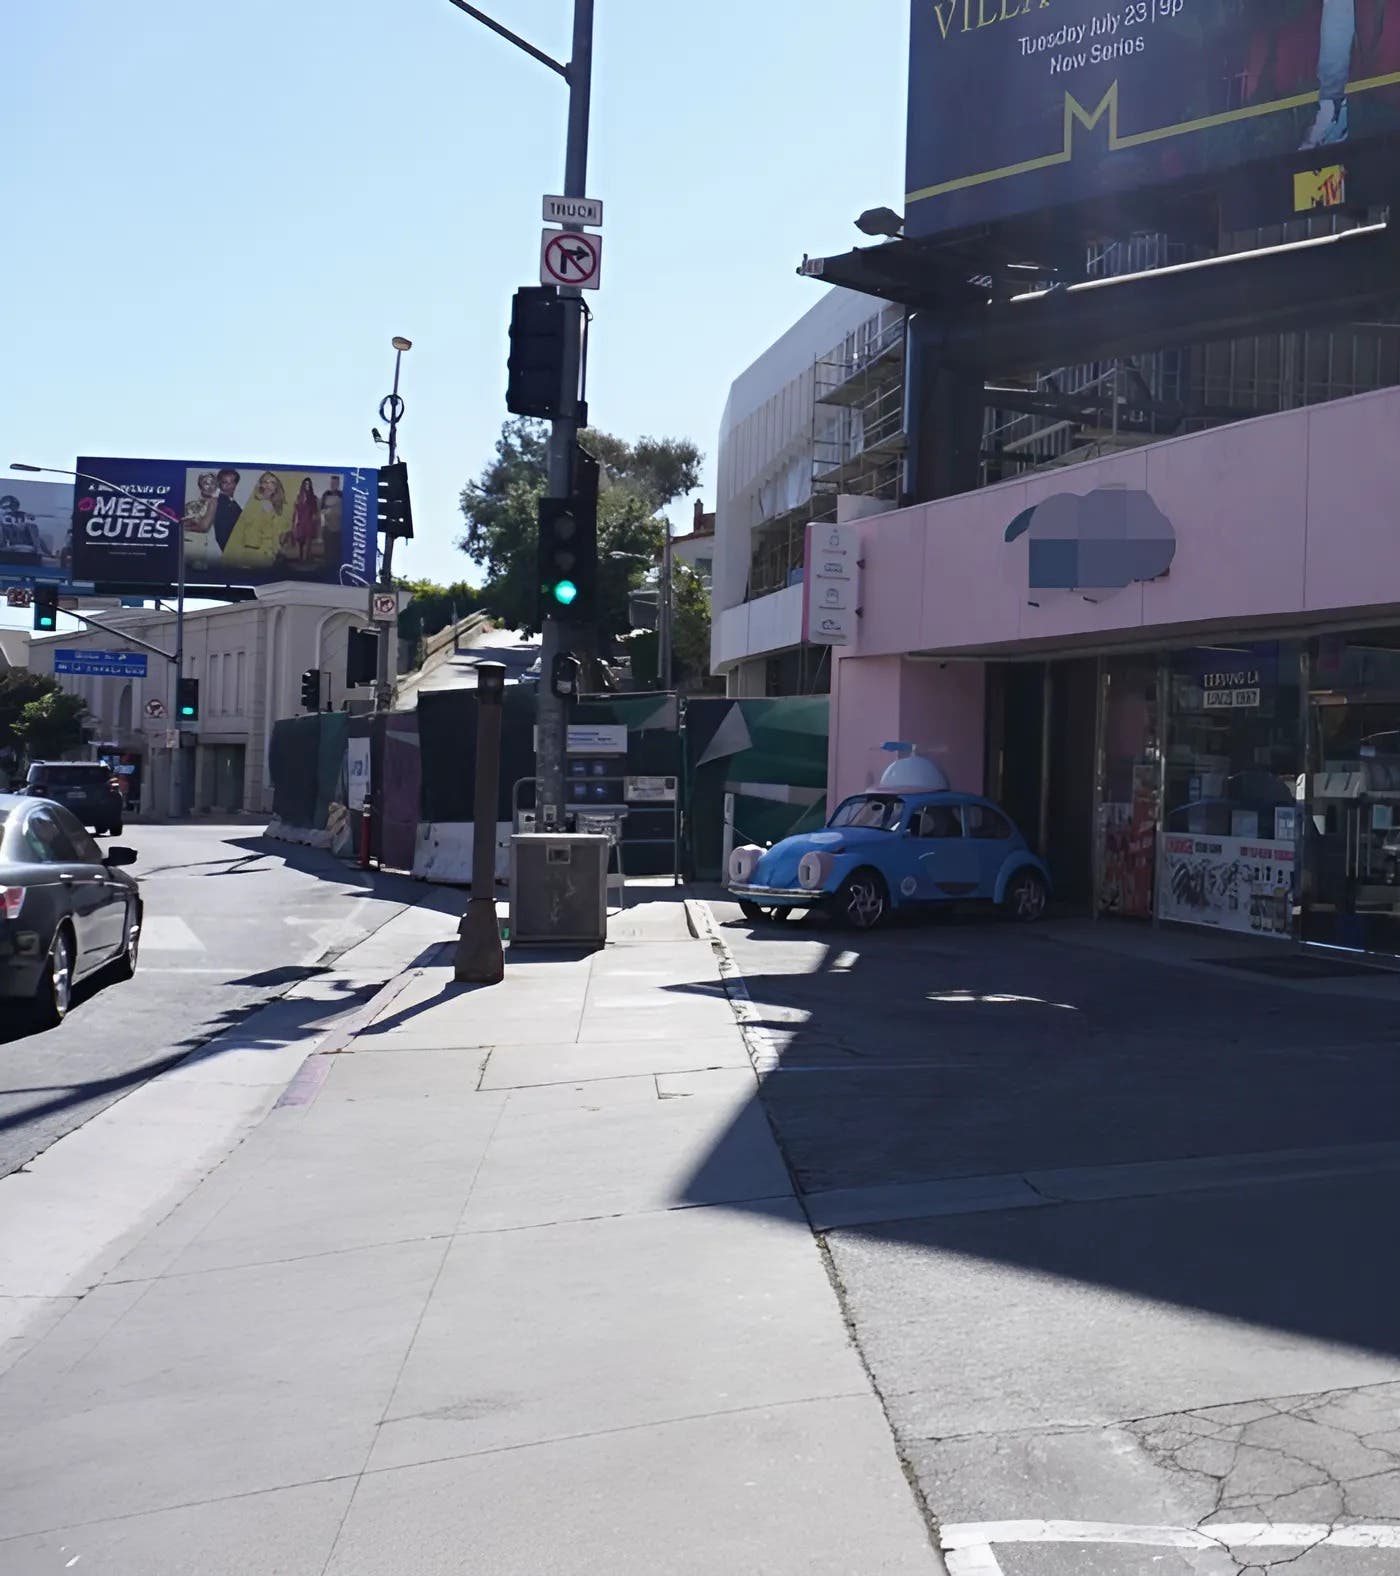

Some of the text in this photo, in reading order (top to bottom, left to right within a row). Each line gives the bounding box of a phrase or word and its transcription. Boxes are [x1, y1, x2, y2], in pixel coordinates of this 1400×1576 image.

[1018, 24, 1086, 56] Tuesday
[1090, 13, 1121, 36] July
[1050, 36, 1145, 75] New Series
[93, 496, 166, 518] MEET
[85, 517, 170, 539] CUTES
